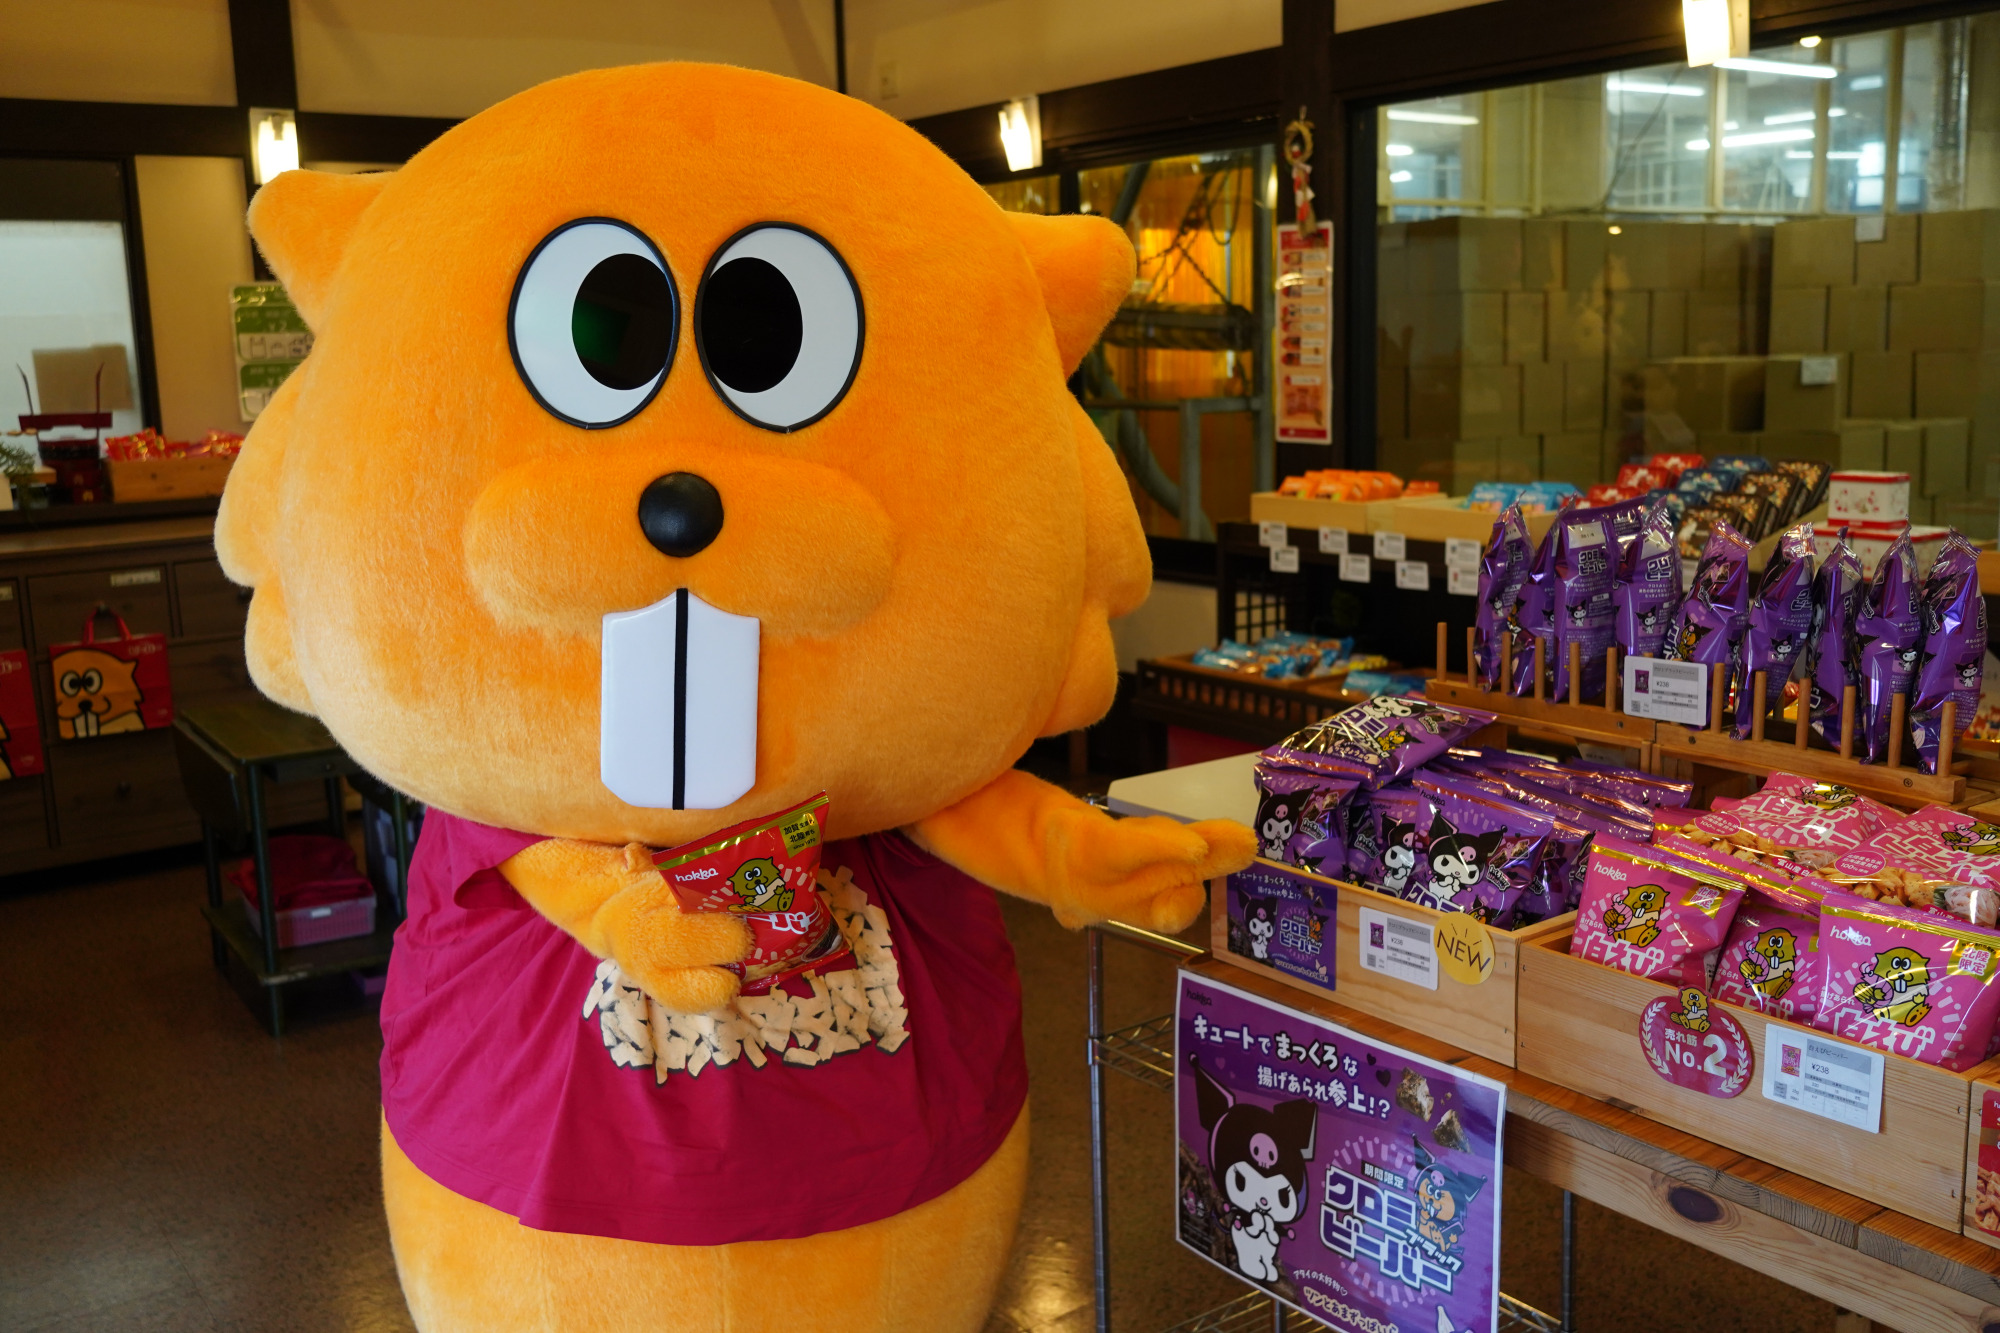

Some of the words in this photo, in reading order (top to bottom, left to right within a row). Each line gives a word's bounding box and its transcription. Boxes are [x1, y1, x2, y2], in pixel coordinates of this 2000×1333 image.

[1420, 791, 1446, 807] hokka
[675, 868, 719, 883] hokka
[1594, 861, 1627, 881] hokka
[1696, 886, 1720, 899] 北陸
[1830, 925, 1871, 947] hokka
[1437, 929, 1491, 974] NEW
[1962, 946, 1991, 963] 北陸
[1958, 958, 1988, 977] 限定
[1665, 1028, 1697, 1047] 売れ筋
[1665, 1034, 1728, 1078] No.2
[1808, 1045, 1849, 1060] 白えびビーバー
[1811, 1063, 1830, 1075] ¥238
[1364, 1162, 1405, 1190] 期間限定
[1325, 1166, 1416, 1239] クロミ
[1320, 1204, 1453, 1293] ビーバー
[1405, 1228, 1462, 1272] ブラック
